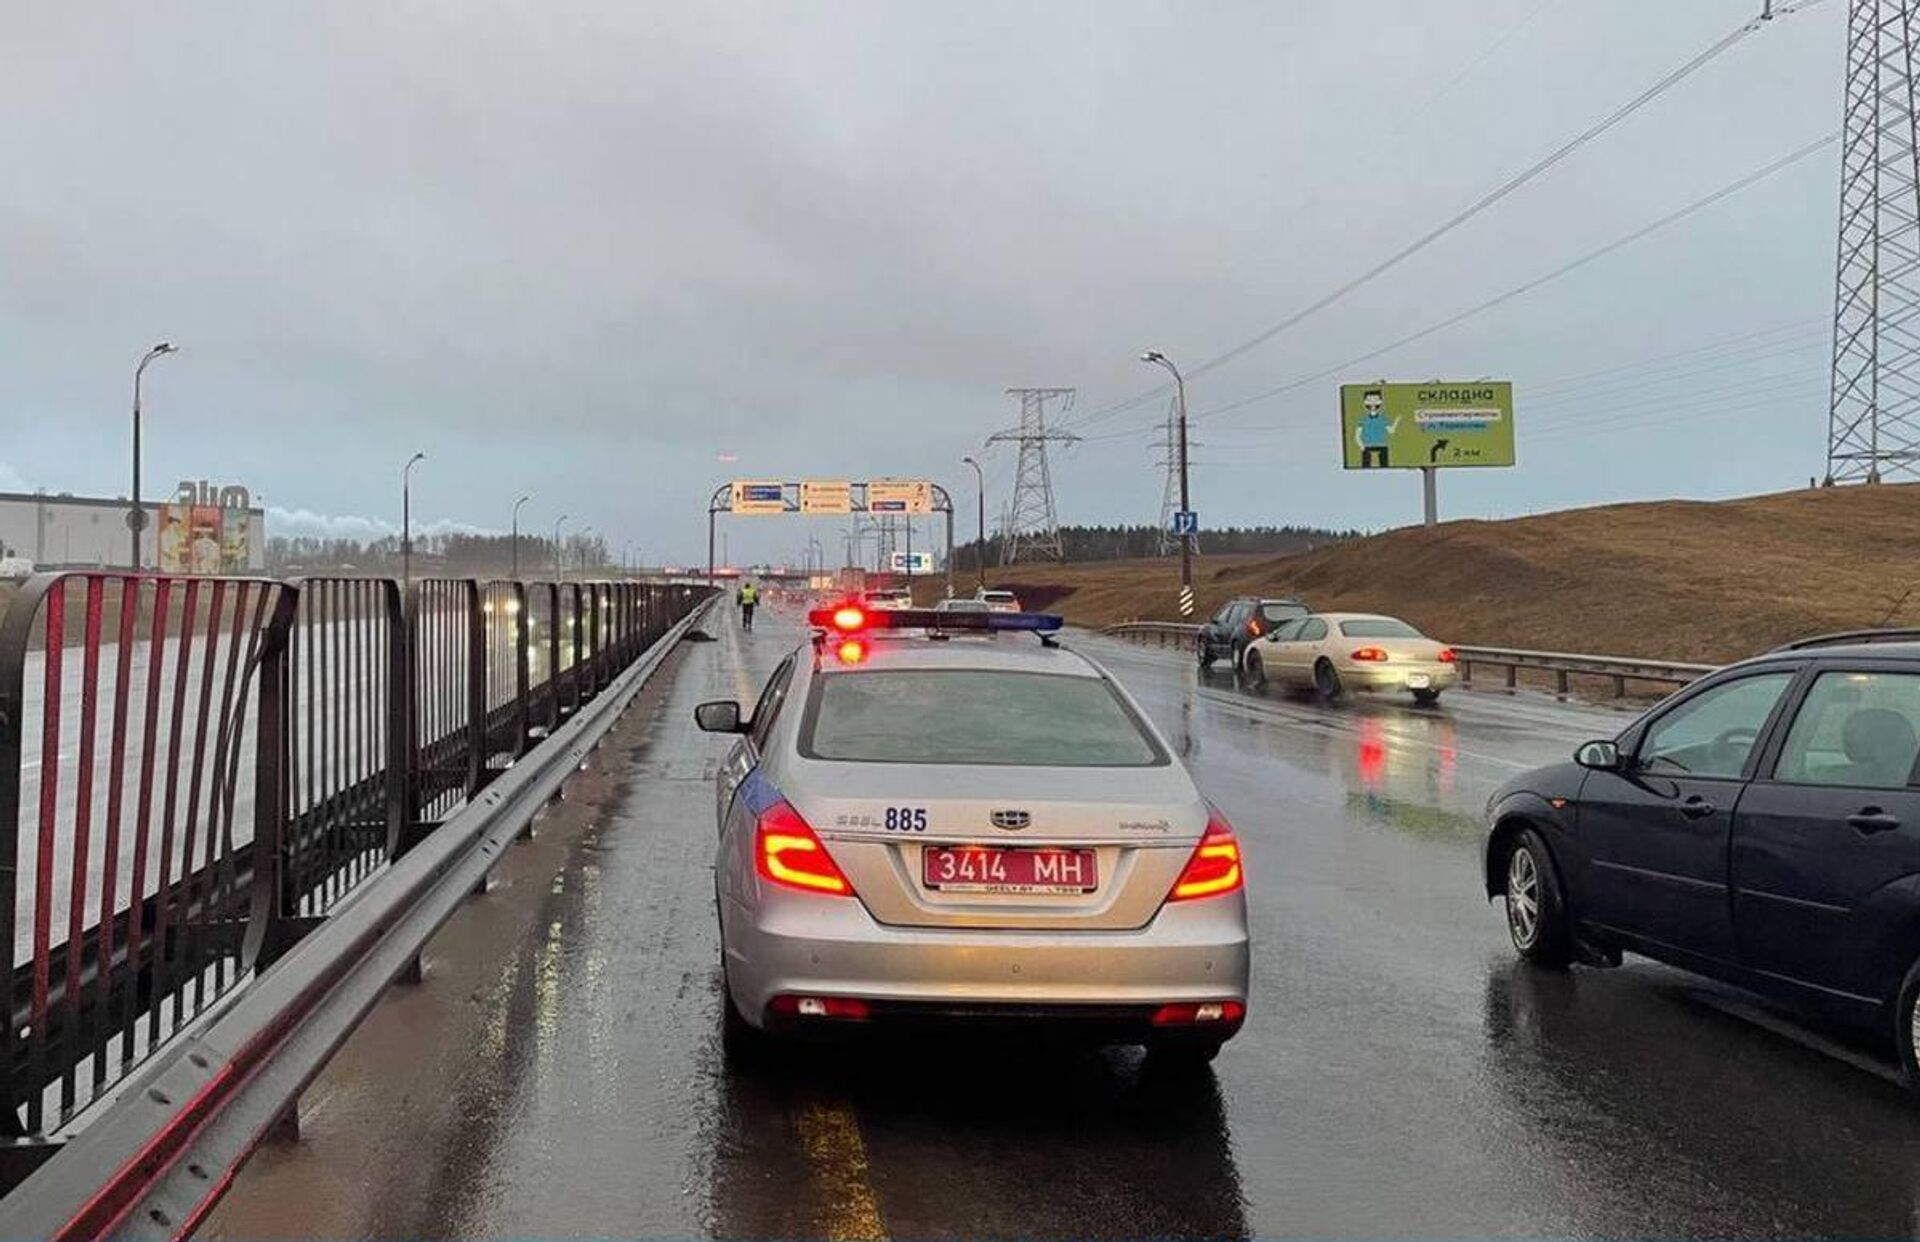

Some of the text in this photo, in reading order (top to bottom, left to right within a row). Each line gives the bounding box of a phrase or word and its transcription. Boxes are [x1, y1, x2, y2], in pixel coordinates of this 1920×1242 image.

[1417, 389, 1494, 403] складна
[885, 807, 927, 831] 885
[938, 852, 1082, 883] 3414 MH
